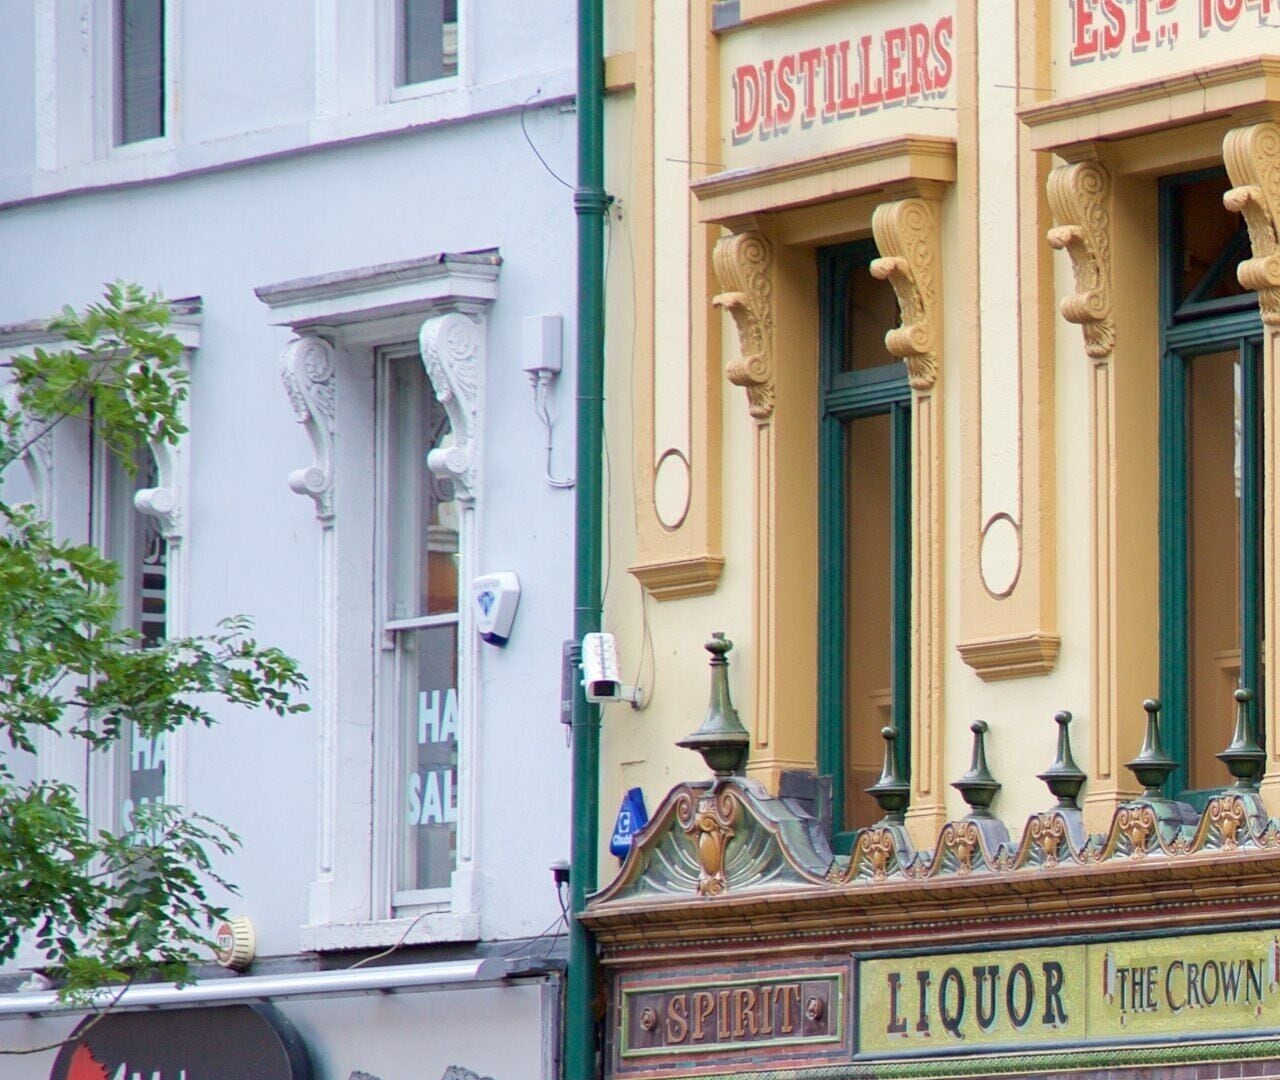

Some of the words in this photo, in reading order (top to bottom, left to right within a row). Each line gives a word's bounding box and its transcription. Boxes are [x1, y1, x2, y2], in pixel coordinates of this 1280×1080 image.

[733, 16, 954, 142] DISTILLERS
[664, 984, 801, 1043] SPIRIT
[887, 961, 1069, 1040] LIQUOR
[1115, 965, 1159, 1014] THE
[1165, 957, 1266, 1015] CROWN
